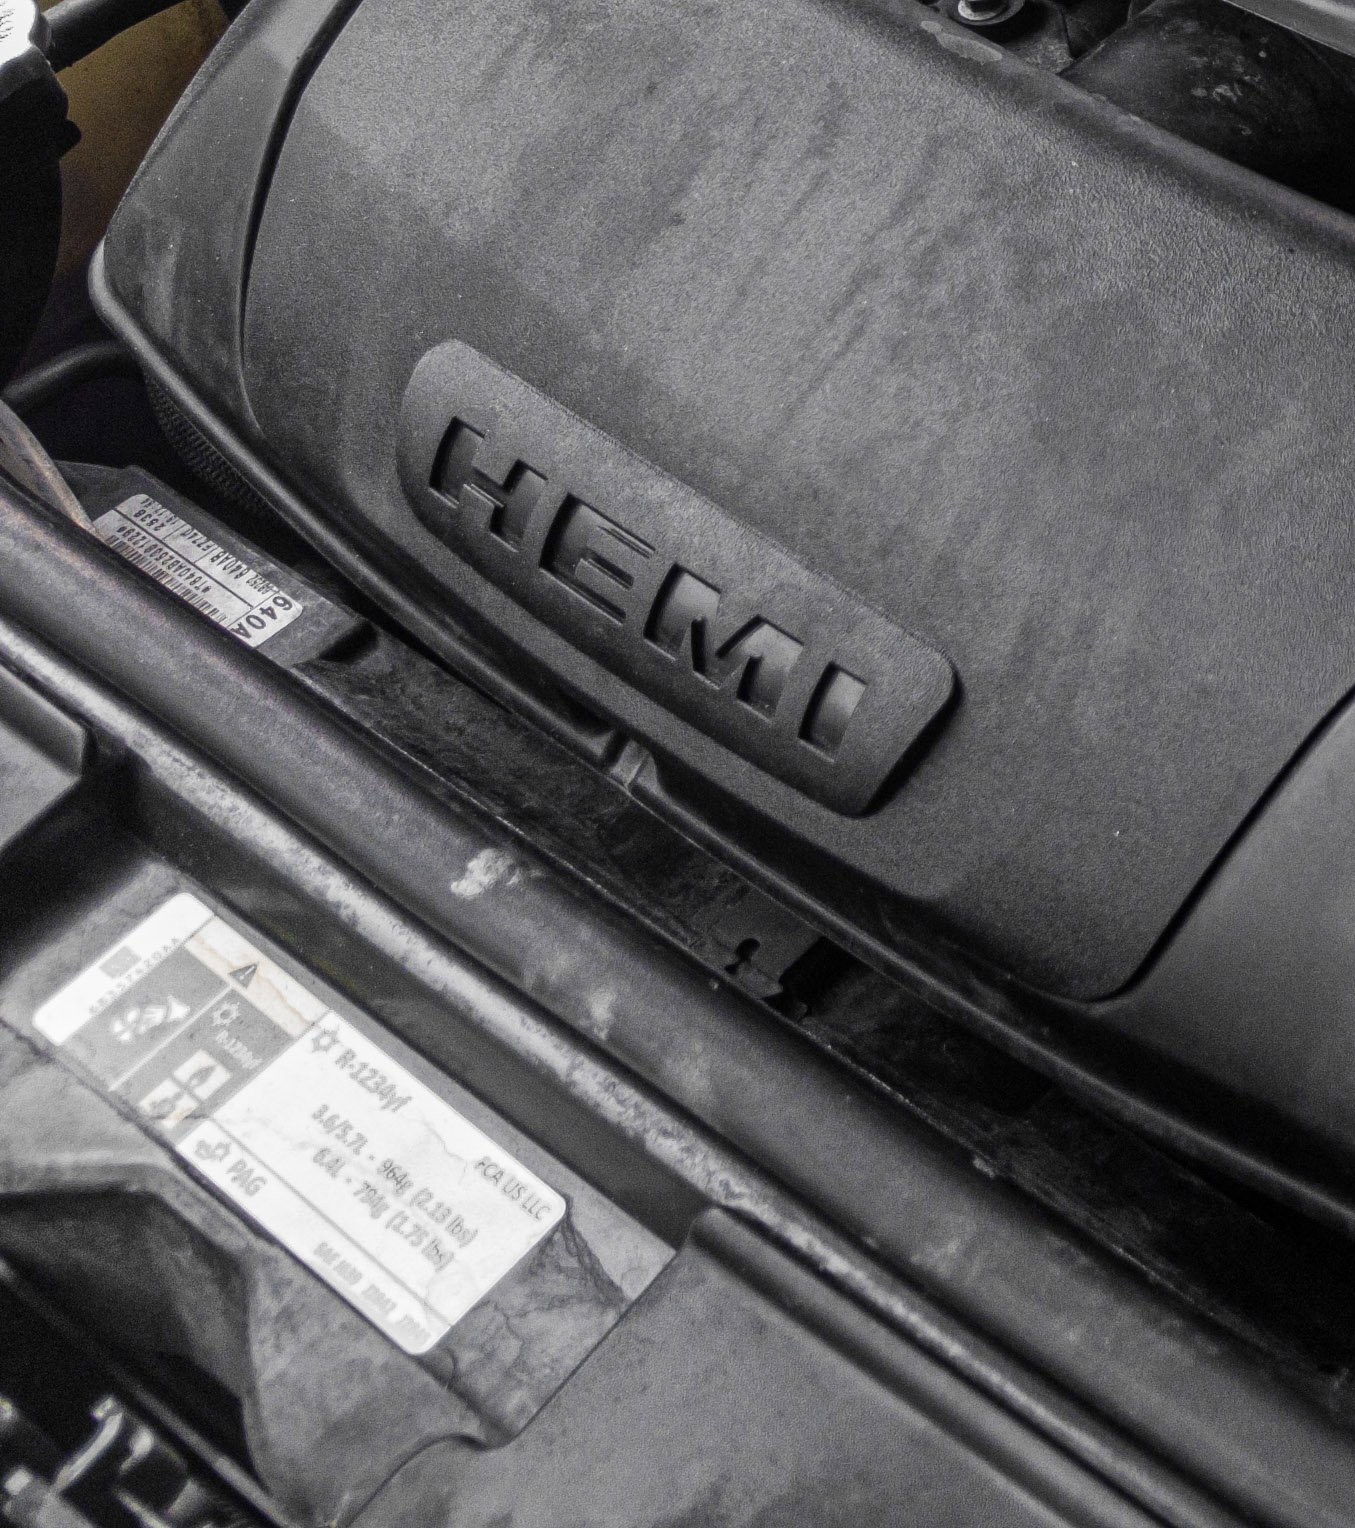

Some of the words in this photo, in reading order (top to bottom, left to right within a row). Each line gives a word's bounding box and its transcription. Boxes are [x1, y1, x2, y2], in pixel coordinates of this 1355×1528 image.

[230, 595, 293, 640] 640A
[428, 415, 870, 763] HEMI
[334, 1048, 413, 1113] R-1234yf
[225, 1158, 268, 1197] PAG
[376, 1158, 414, 1198] 964g
[444, 1214, 479, 1249] lbs)
[474, 1155, 504, 1186] FCA
[501, 1177, 528, 1203] US
[521, 1192, 552, 1222] LLC
